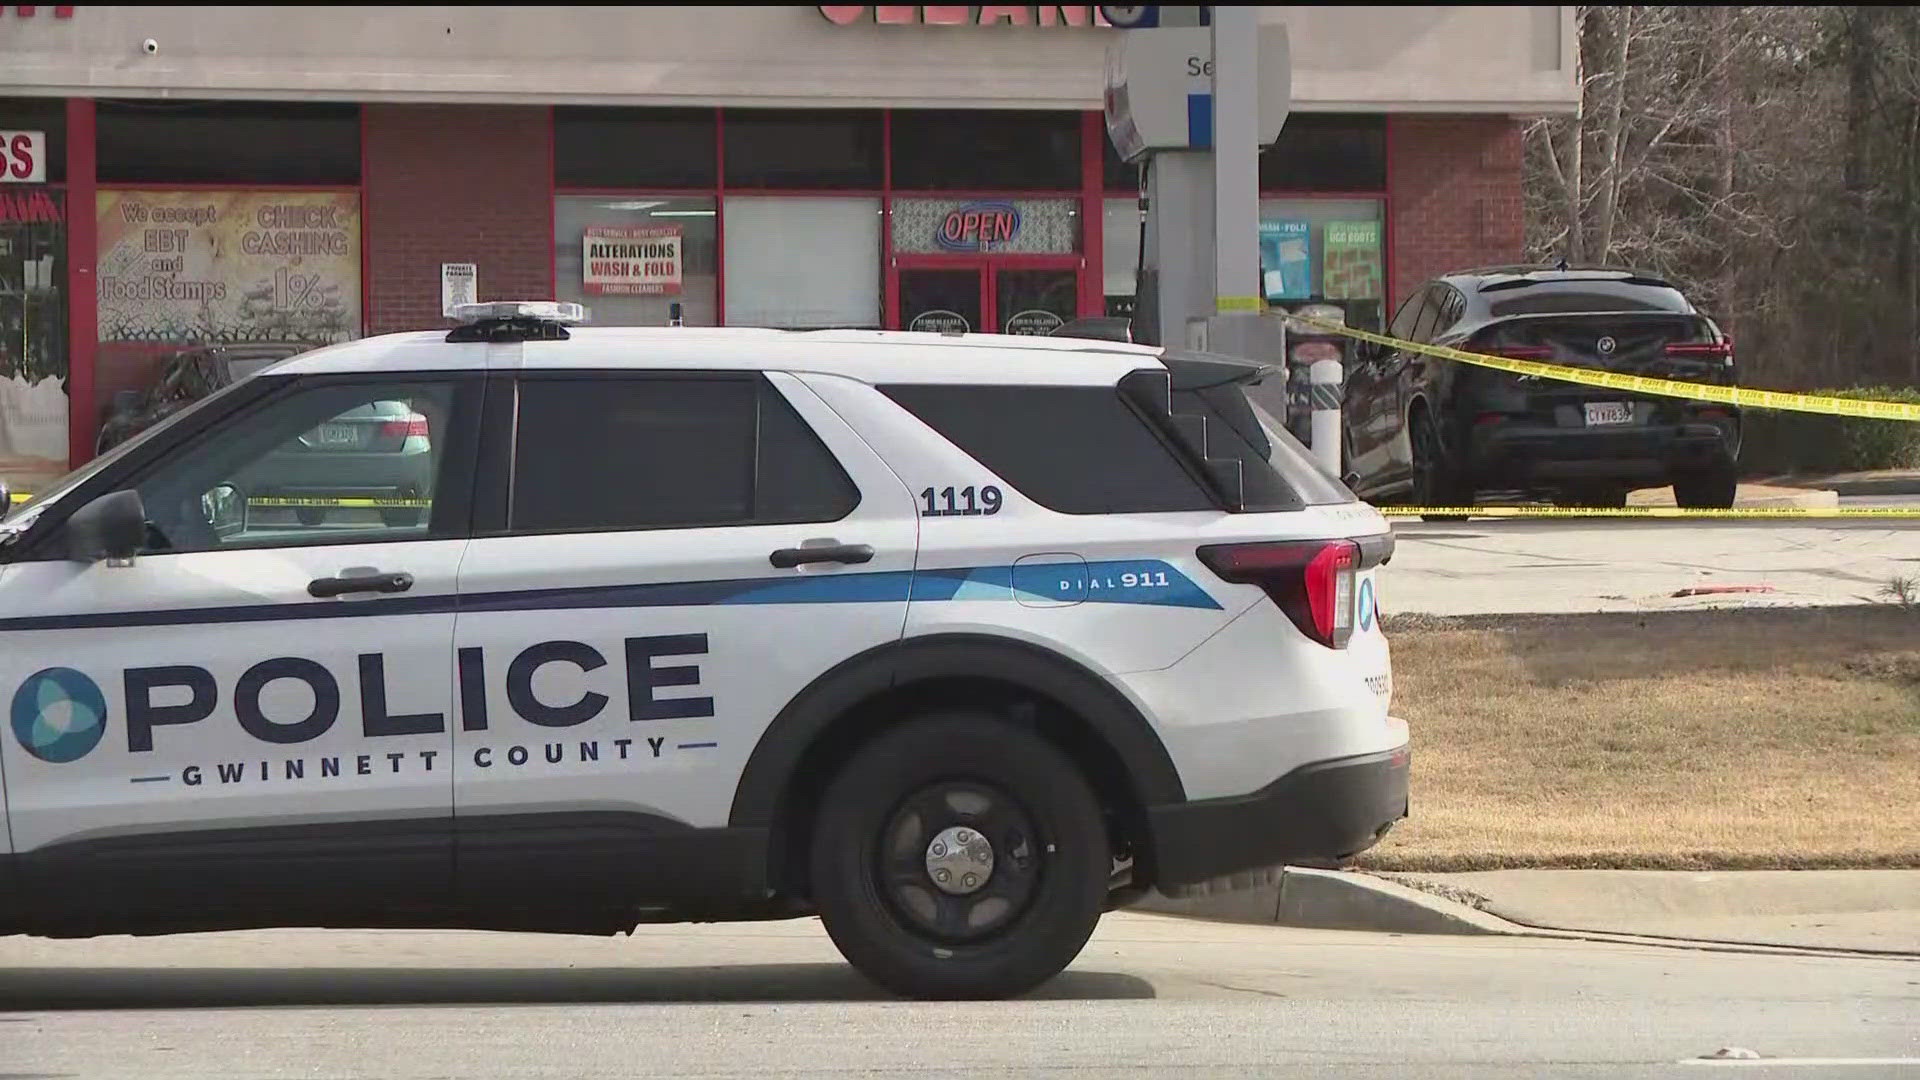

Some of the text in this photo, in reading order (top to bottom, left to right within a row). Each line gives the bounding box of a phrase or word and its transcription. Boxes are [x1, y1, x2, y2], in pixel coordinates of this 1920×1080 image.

[121, 202, 217, 226] We accept
[256, 204, 338, 229] CHECK
[945, 212, 1013, 242] OPEN
[144, 229, 189, 252] EBT
[241, 231, 348, 256] CASHING
[590, 243, 675, 259] ALTERATIONS
[151, 256, 183, 273] and
[590, 261, 675, 277] WASH & FOLD
[103, 275, 227, 307] Food Stamps
[274, 267, 326, 314] 1%
[921, 485, 1003, 517] 1119
[1060, 573, 1168, 590] DIAL 911
[124, 633, 714, 752] POLICE
[183, 737, 665, 786] GWINNETT COUNTY
